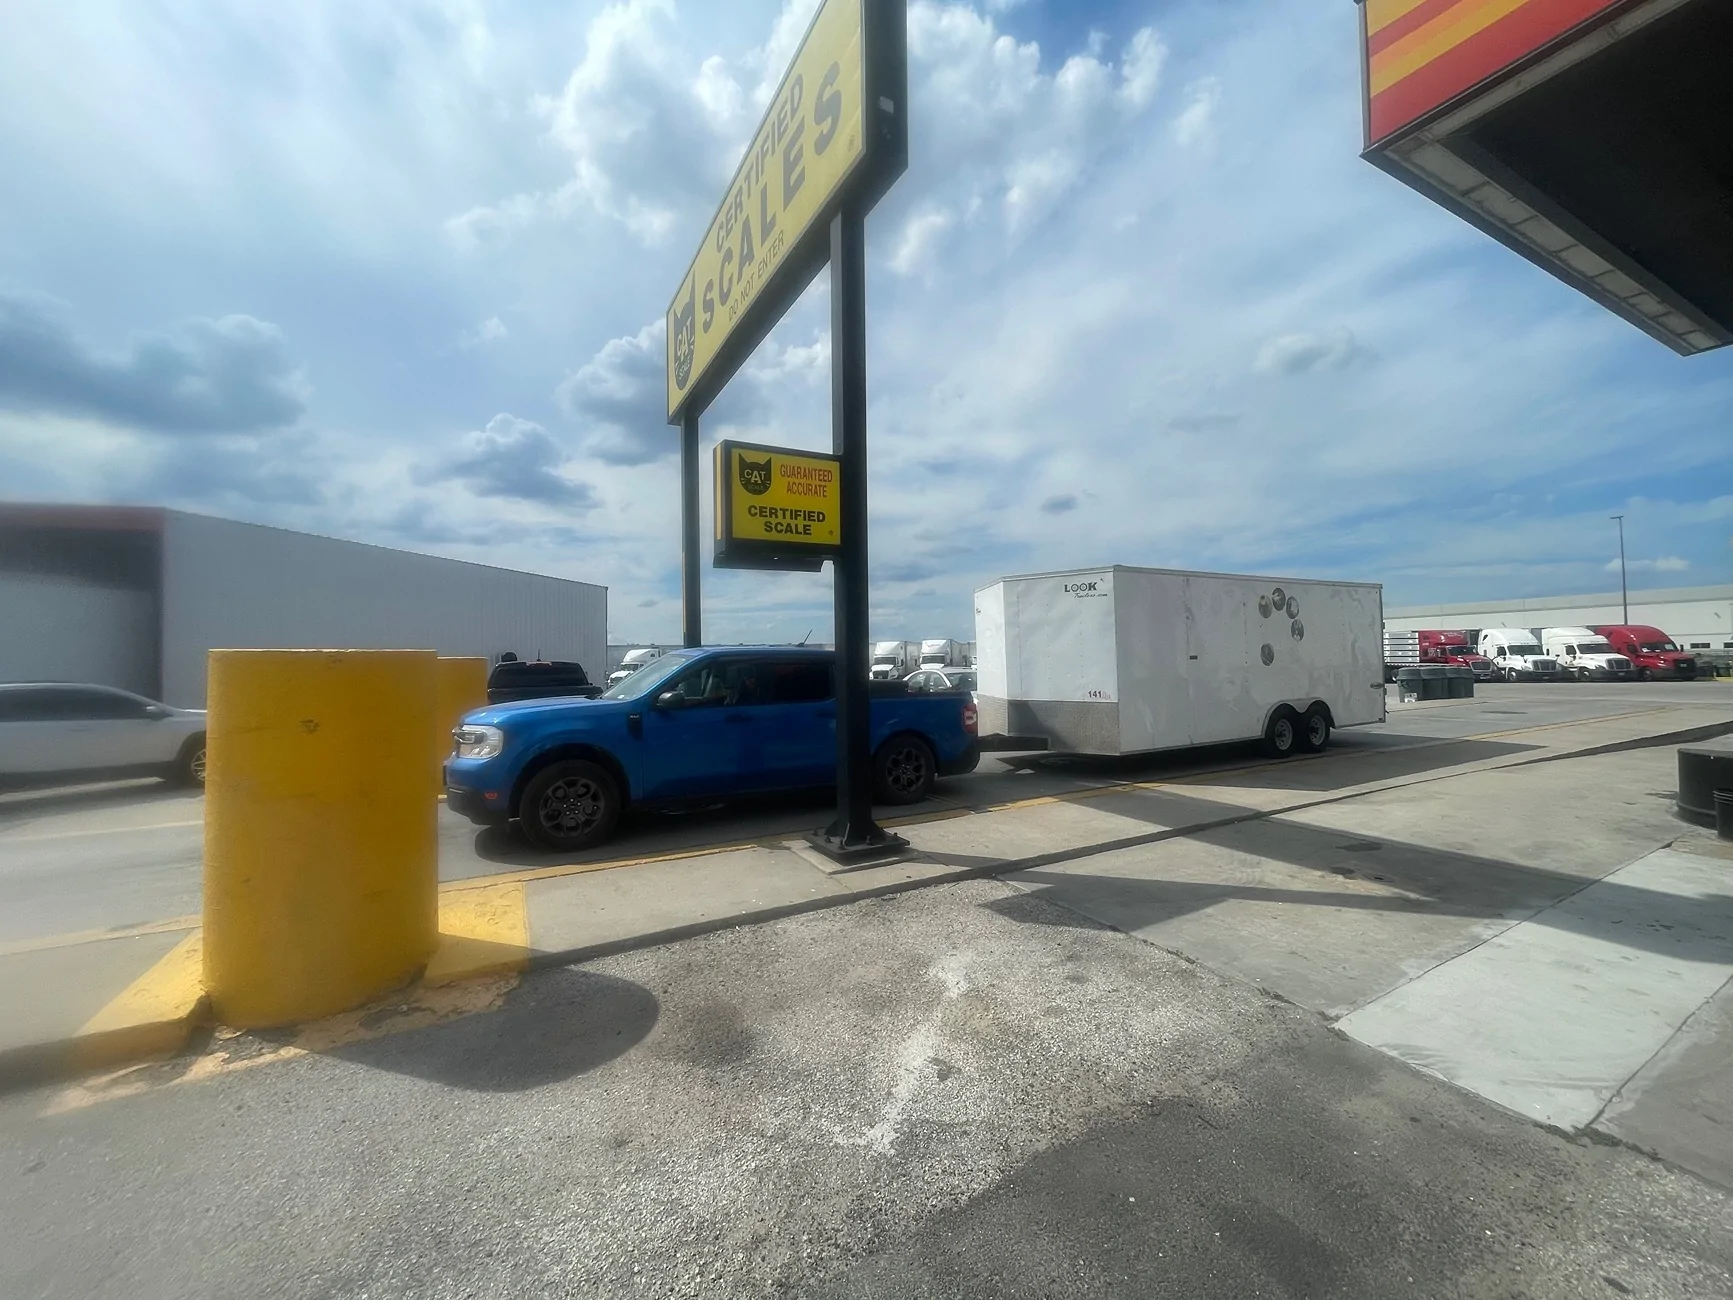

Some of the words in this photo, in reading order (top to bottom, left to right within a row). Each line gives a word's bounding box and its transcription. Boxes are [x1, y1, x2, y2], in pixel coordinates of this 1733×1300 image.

[716, 73, 803, 253] CERTIFIED
[701, 61, 842, 334] SCALES
[729, 298, 738, 321] DO
[741, 272, 754, 304] NOT
[757, 229, 785, 280] ENTER
[676, 316, 692, 362] CAT
[744, 469, 765, 483] CAT
[780, 464, 832, 482] GUARANTEED
[786, 482, 827, 497] ACCURATE
[747, 505, 825, 522] CERTIFIED
[764, 521, 811, 535] SCALE
[1064, 582, 1098, 593] LOOK
[1088, 690, 1102, 698] 141
